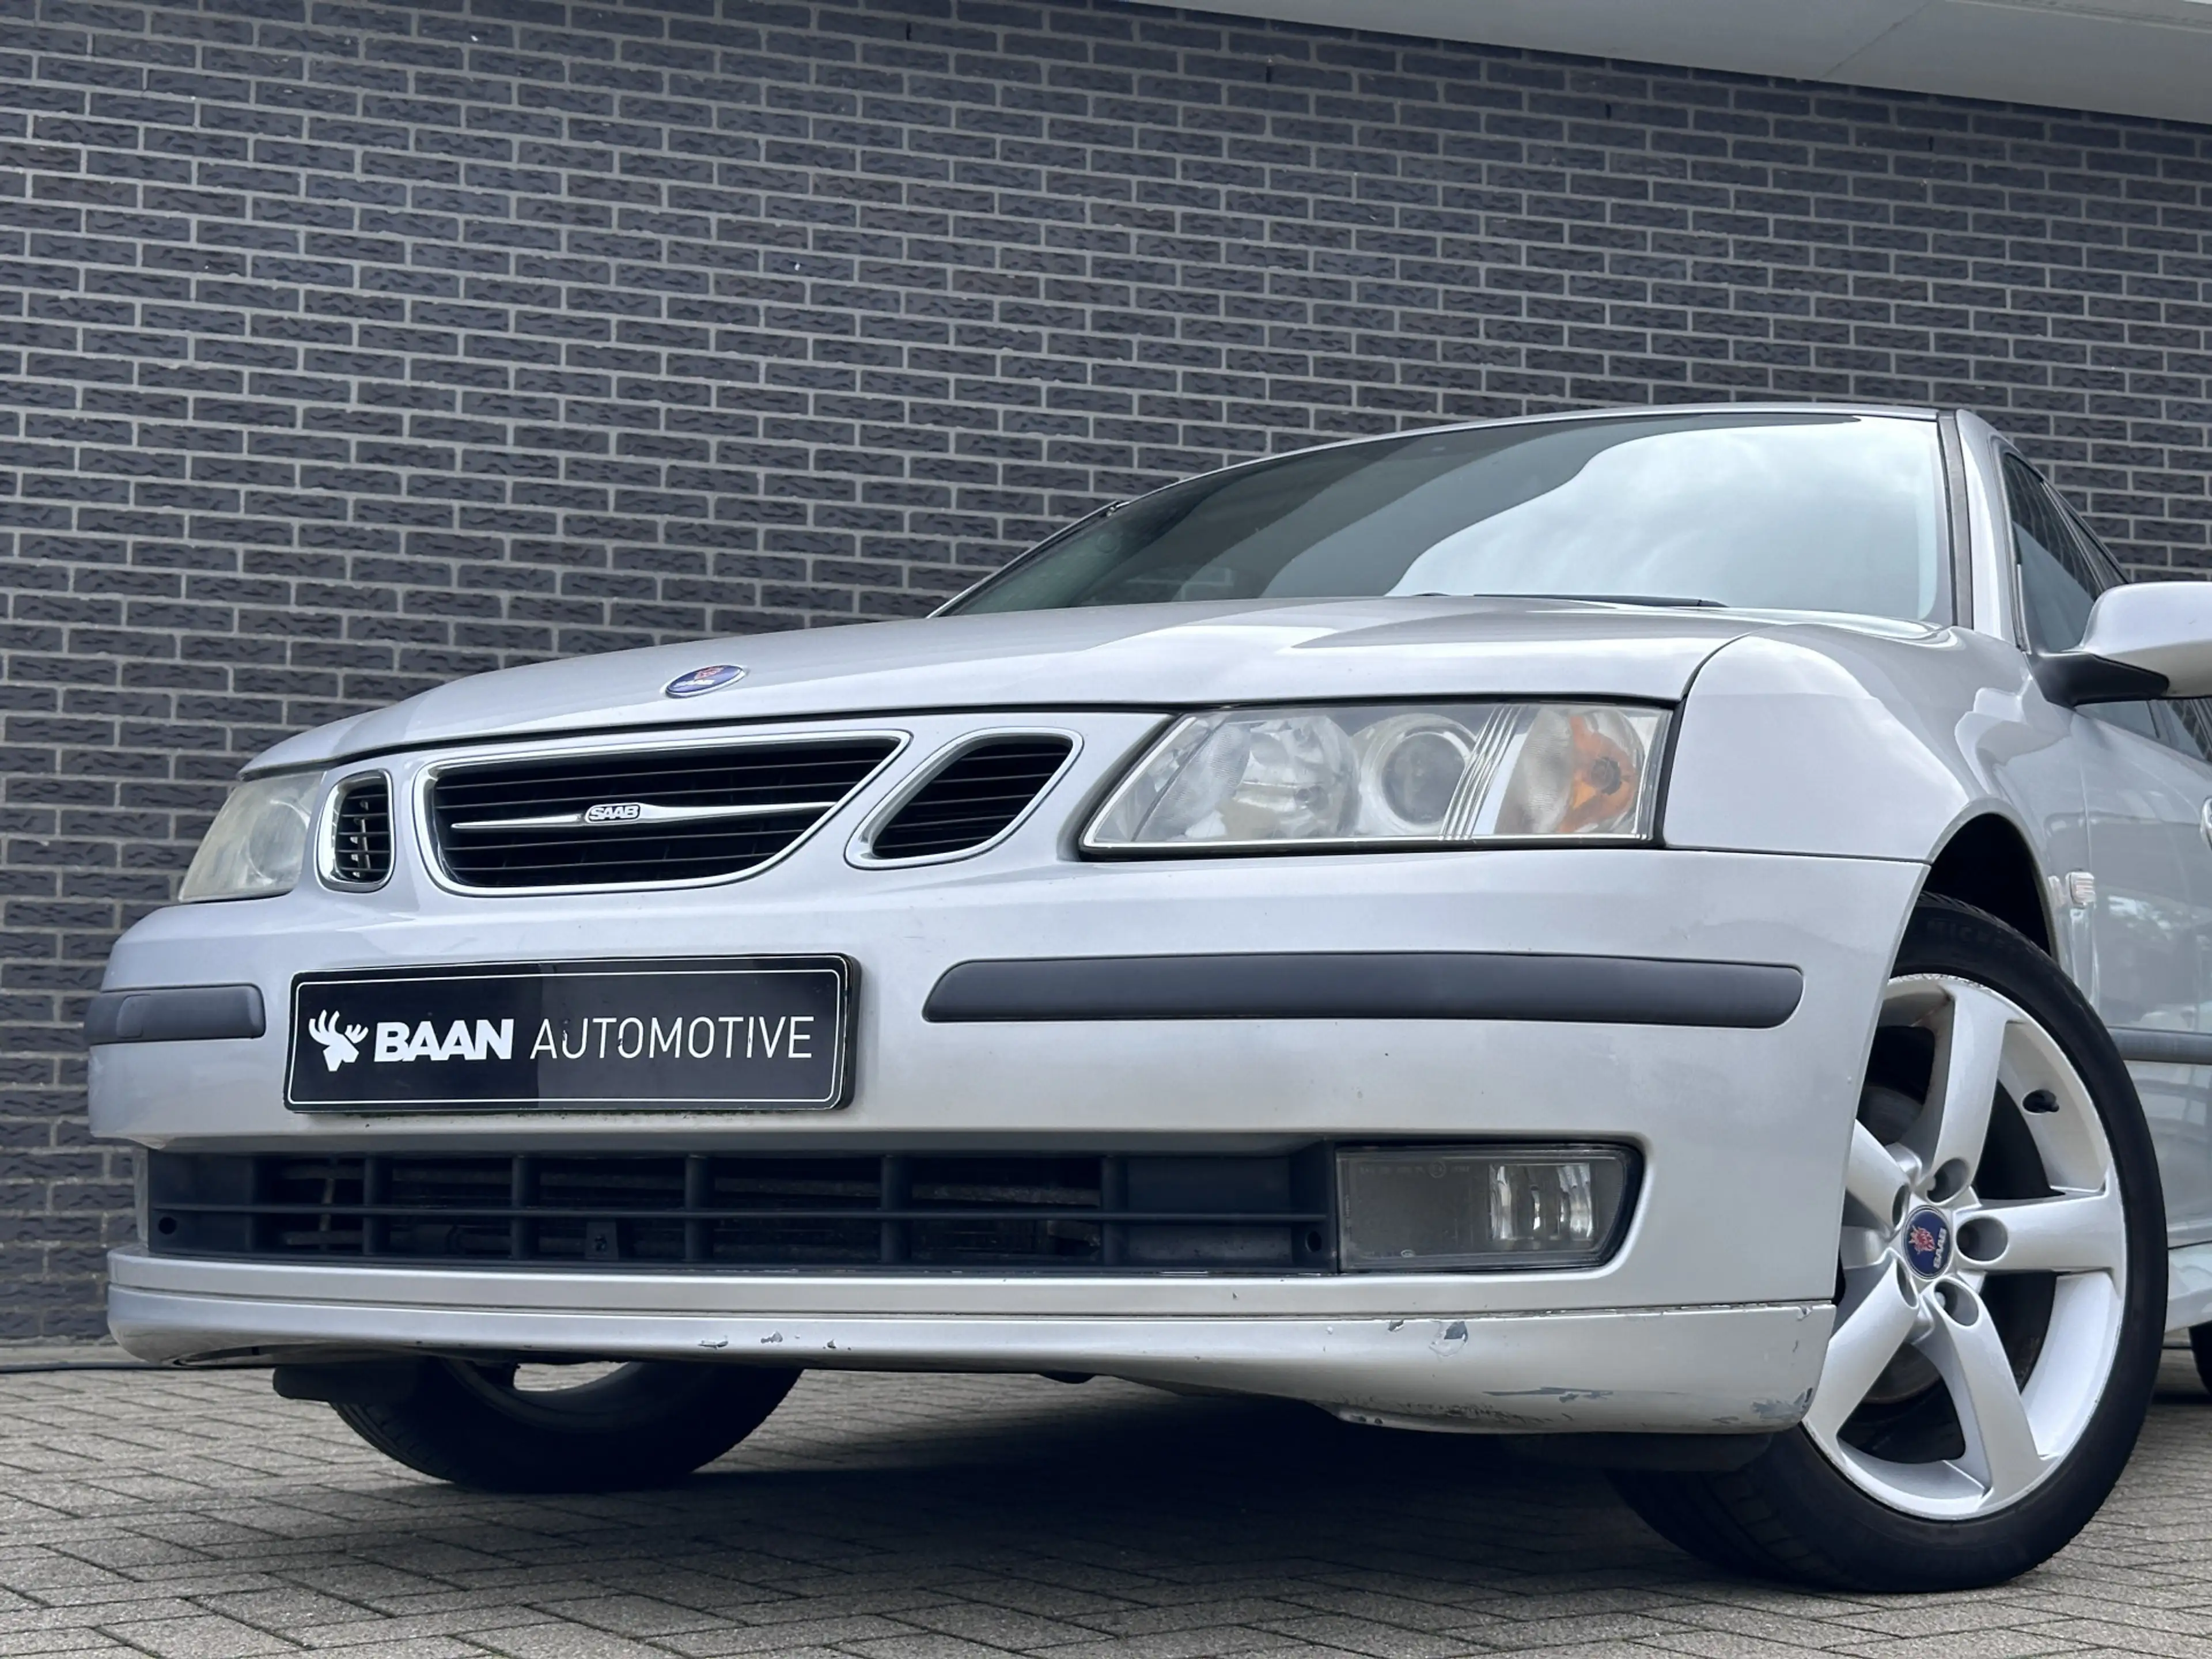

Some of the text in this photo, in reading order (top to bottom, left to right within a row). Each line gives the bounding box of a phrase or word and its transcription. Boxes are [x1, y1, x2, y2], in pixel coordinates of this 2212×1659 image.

[589, 805, 639, 820] SAAB
[373, 1016, 815, 1062] BAAN AUTOMOTIVE
